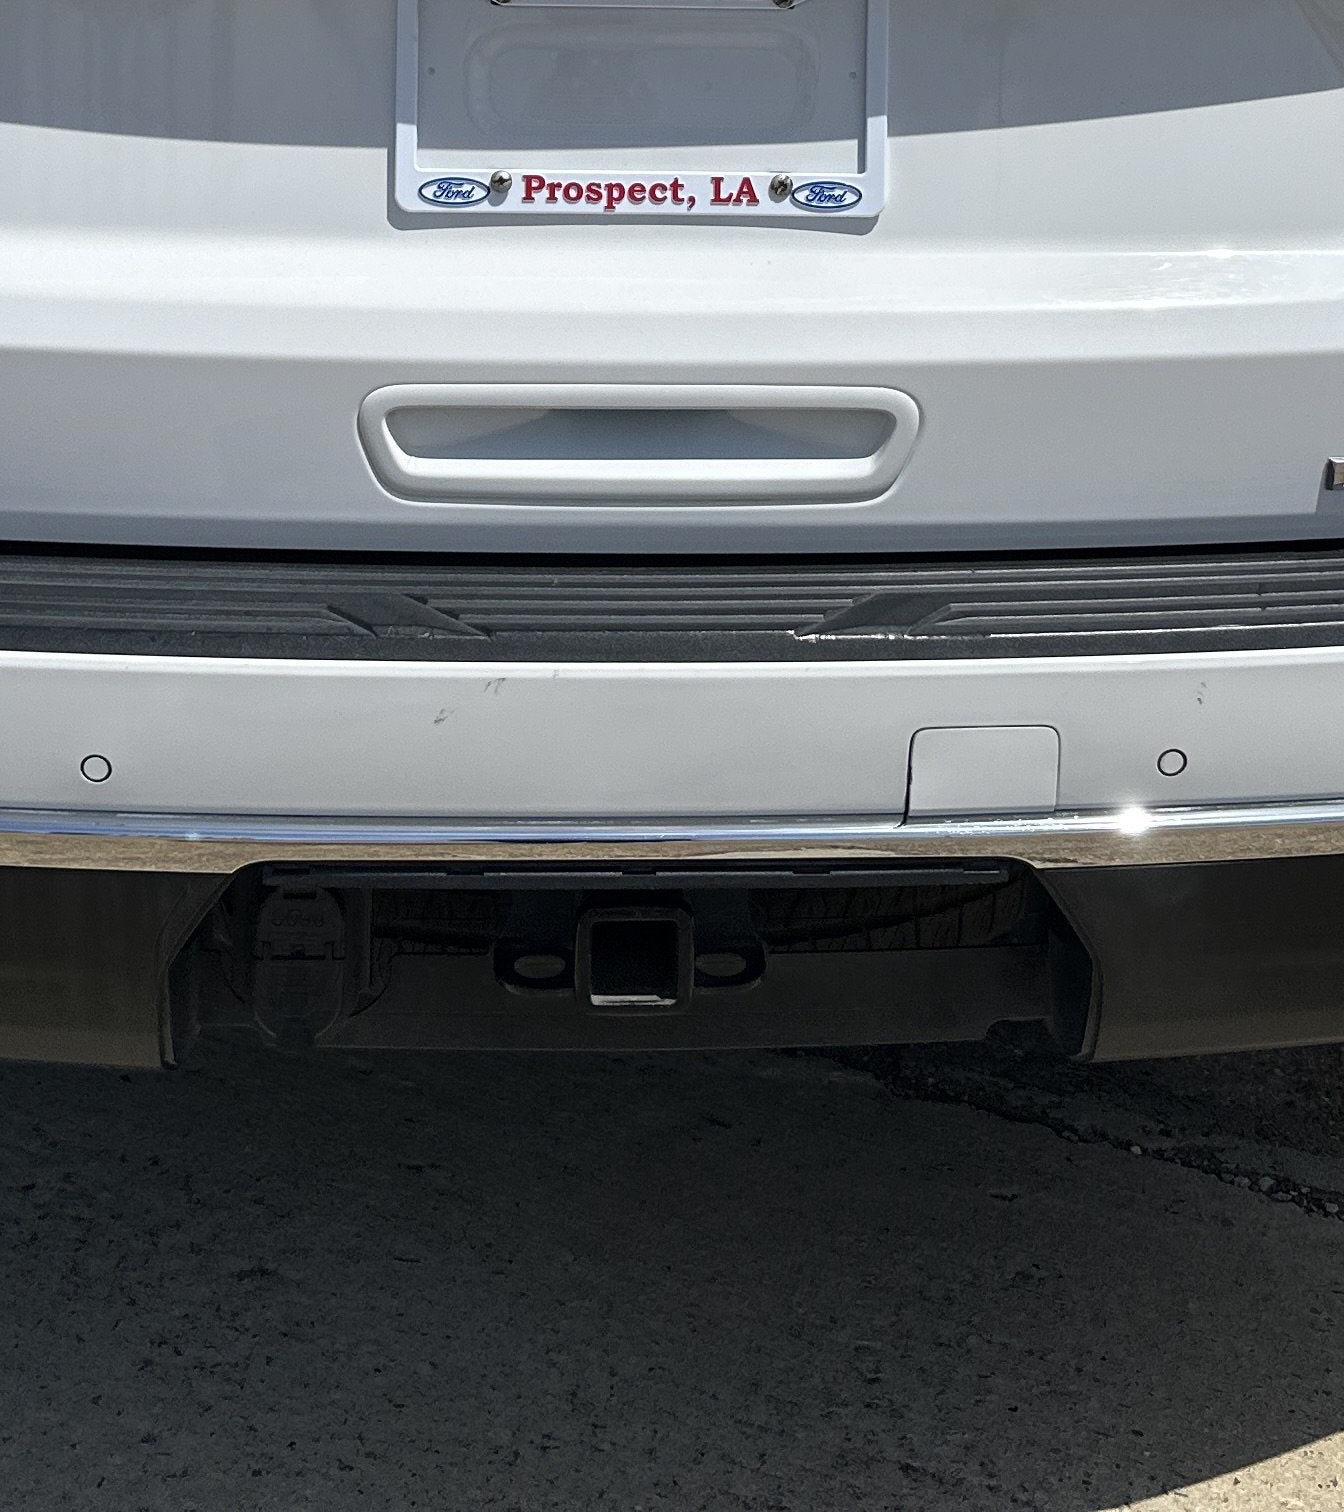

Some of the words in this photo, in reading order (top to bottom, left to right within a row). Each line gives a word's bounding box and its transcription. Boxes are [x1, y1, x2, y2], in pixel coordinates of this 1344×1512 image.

[432, 179, 477, 202] Ford
[521, 174, 697, 213] Prospect,
[709, 176, 761, 206] LA
[805, 184, 849, 206] Ford
